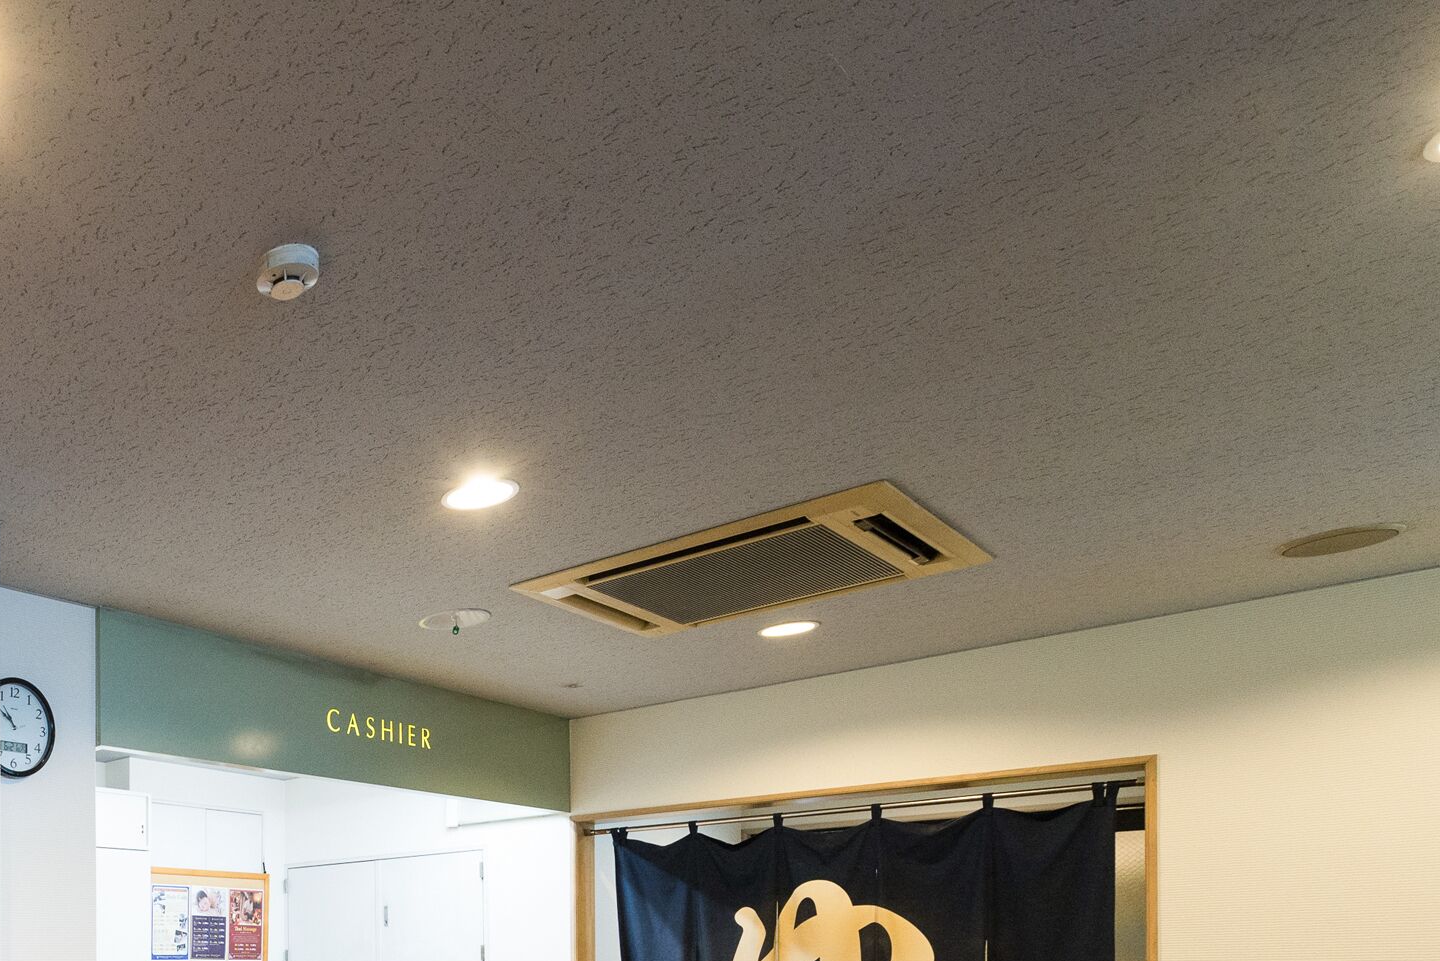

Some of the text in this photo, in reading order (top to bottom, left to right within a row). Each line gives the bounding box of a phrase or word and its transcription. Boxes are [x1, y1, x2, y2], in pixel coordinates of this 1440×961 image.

[10, 687, 20, 699] 12
[35, 709, 42, 720] 2
[39, 726, 46, 738] 3
[326, 708, 431, 750] CASHIER
[34, 743, 41, 753] 4
[10, 758, 18, 769] 6
[25, 754, 32, 765] 5
